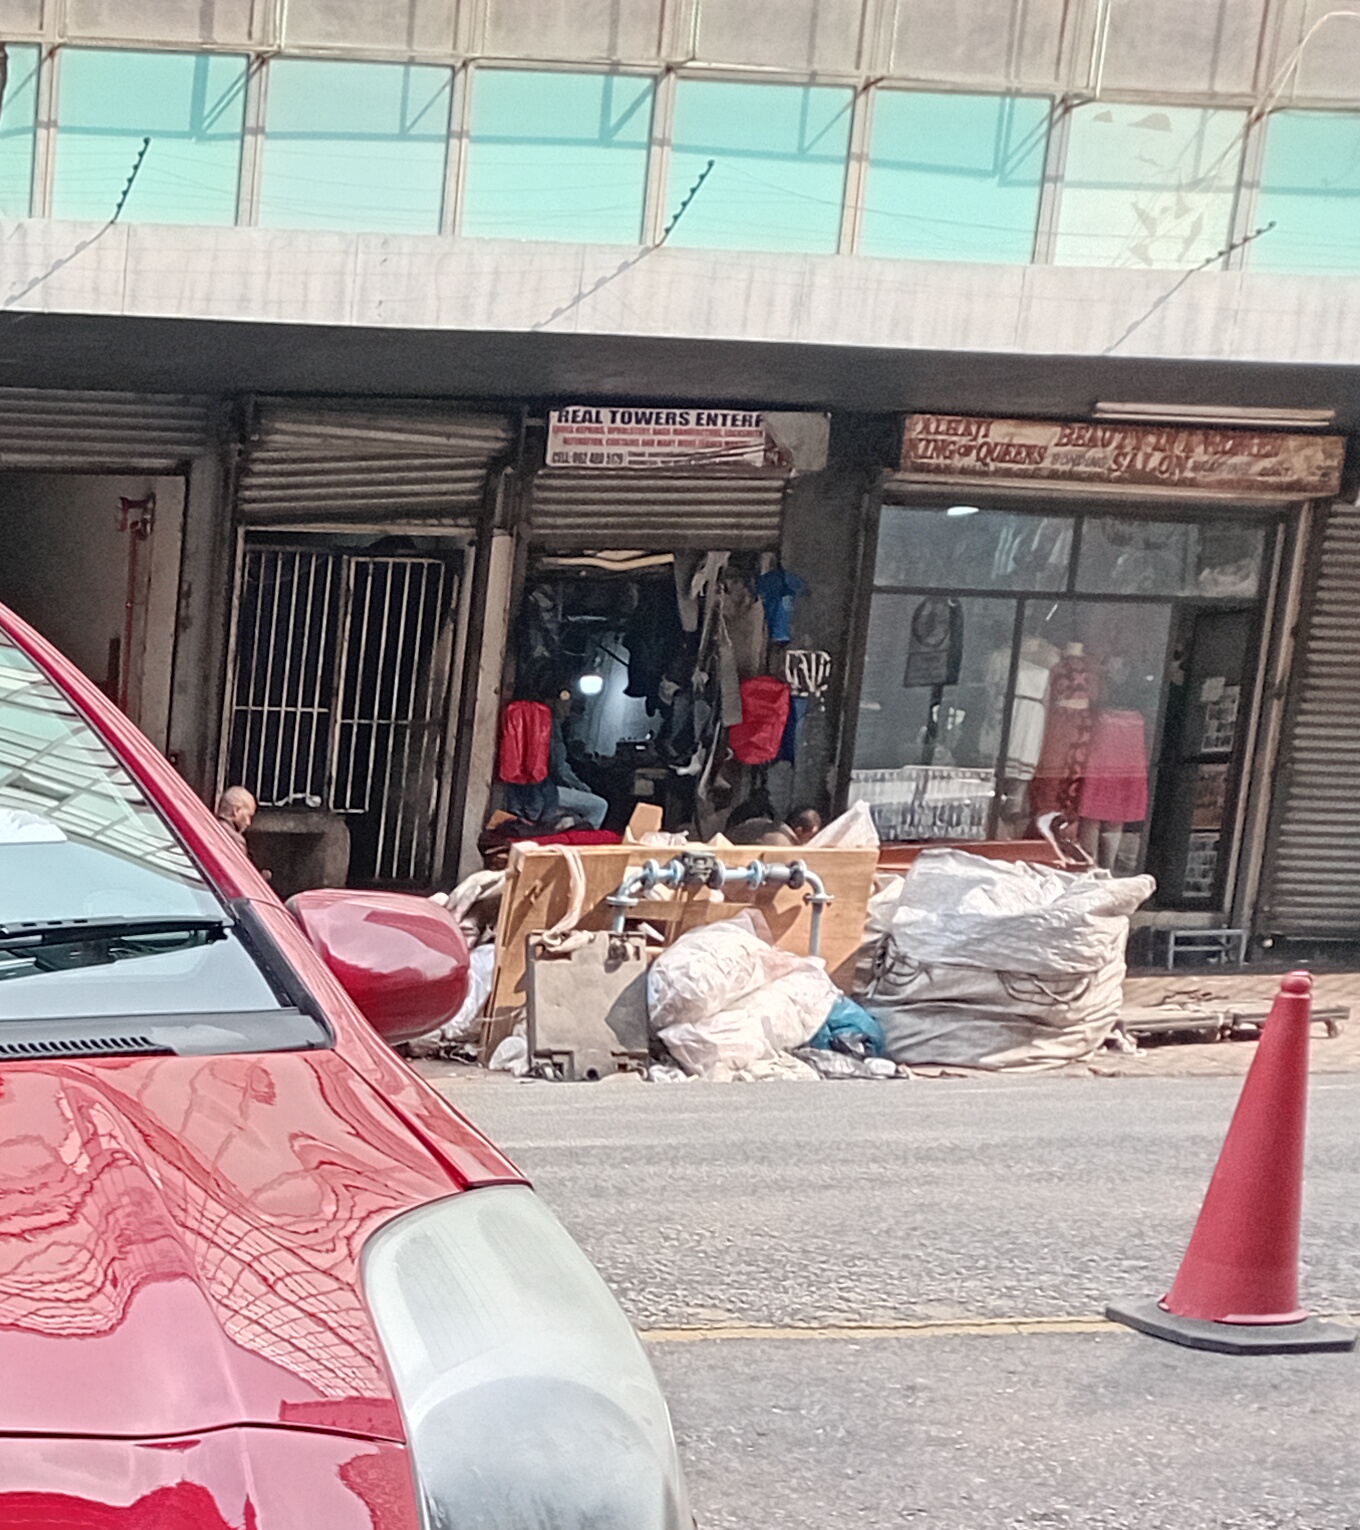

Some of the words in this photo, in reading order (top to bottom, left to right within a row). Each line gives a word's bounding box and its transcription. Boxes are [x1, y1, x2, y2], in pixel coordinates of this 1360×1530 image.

[556, 408, 603, 424] REAL
[610, 410, 691, 427] TOWERS
[974, 441, 1048, 466] QUEENS
[1109, 449, 1192, 479] SALON
